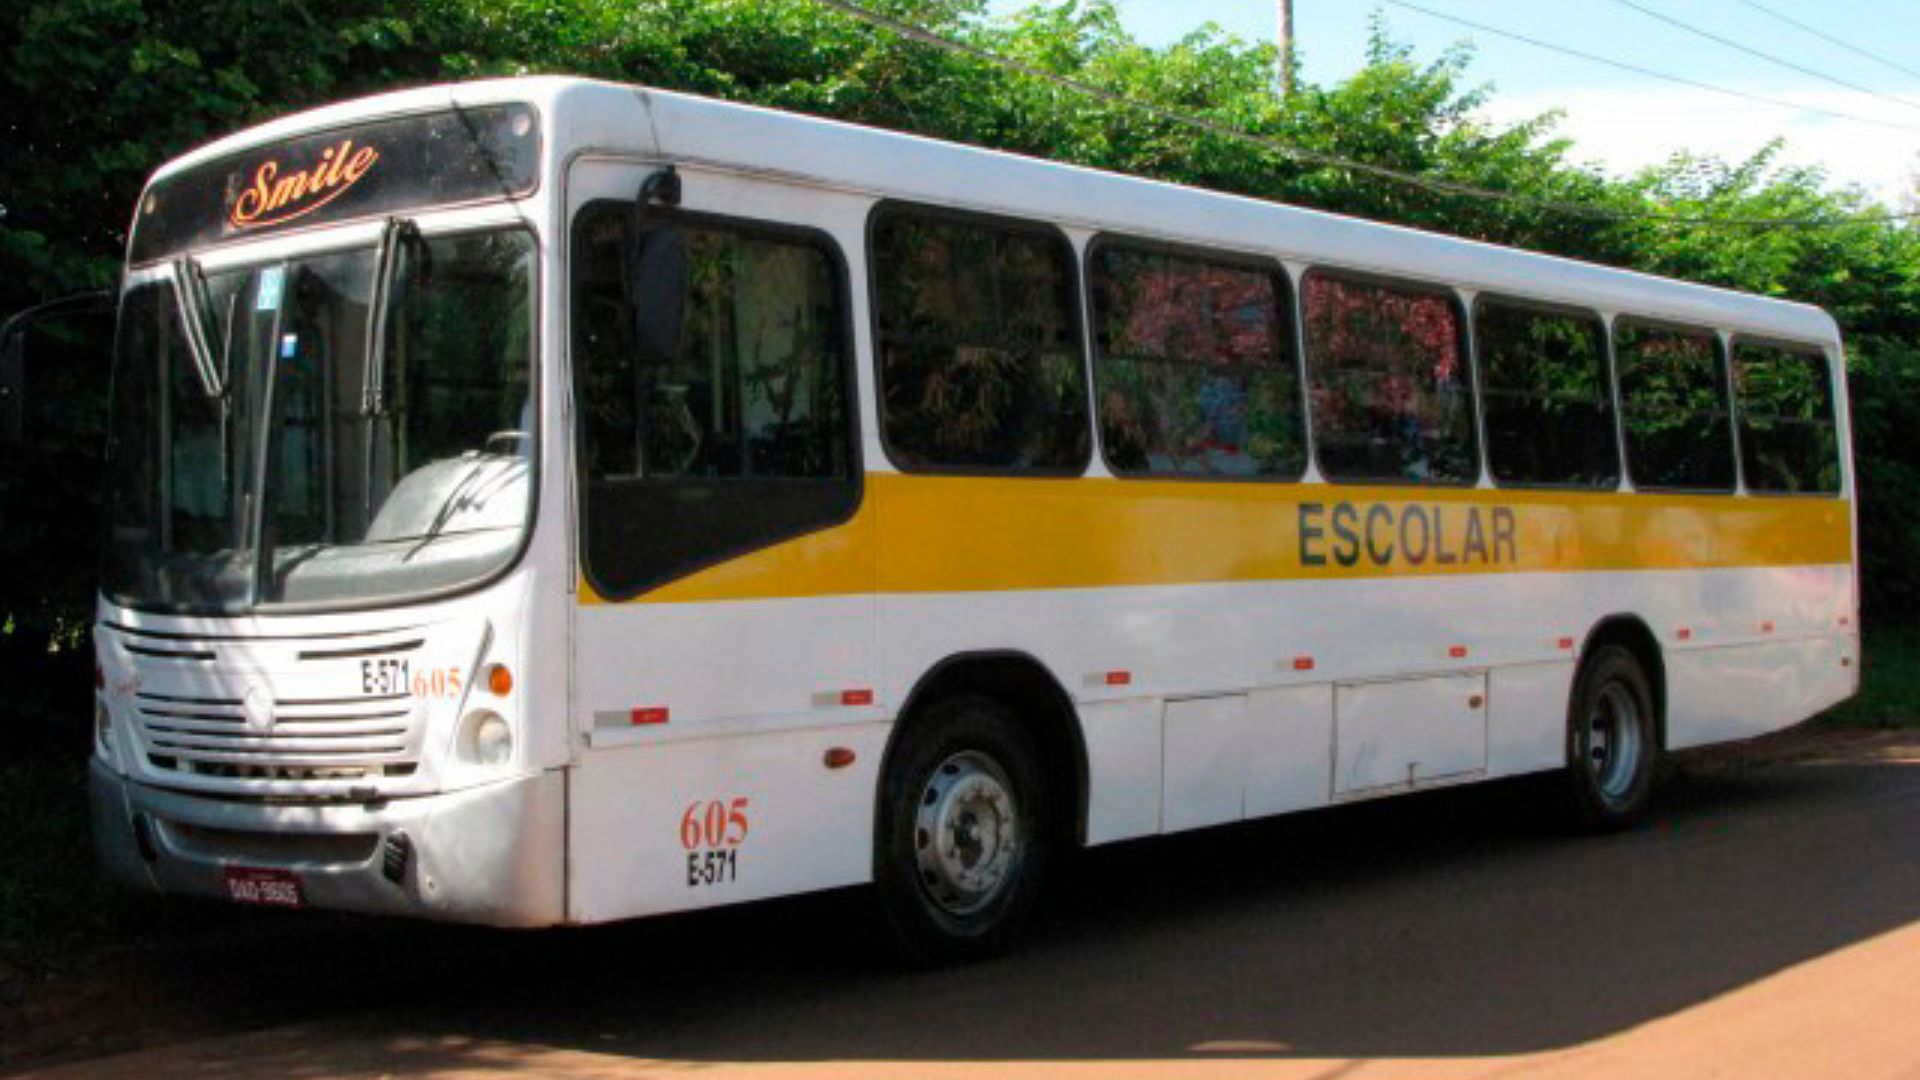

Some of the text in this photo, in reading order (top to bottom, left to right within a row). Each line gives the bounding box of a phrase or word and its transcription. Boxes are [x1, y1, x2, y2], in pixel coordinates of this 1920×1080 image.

[230, 141, 379, 224] Smile
[1298, 502, 1517, 566] ESCOLAR
[360, 659, 409, 694] E-571
[413, 666, 463, 697] 605
[680, 797, 748, 849] 605
[686, 849, 737, 886] E-571
